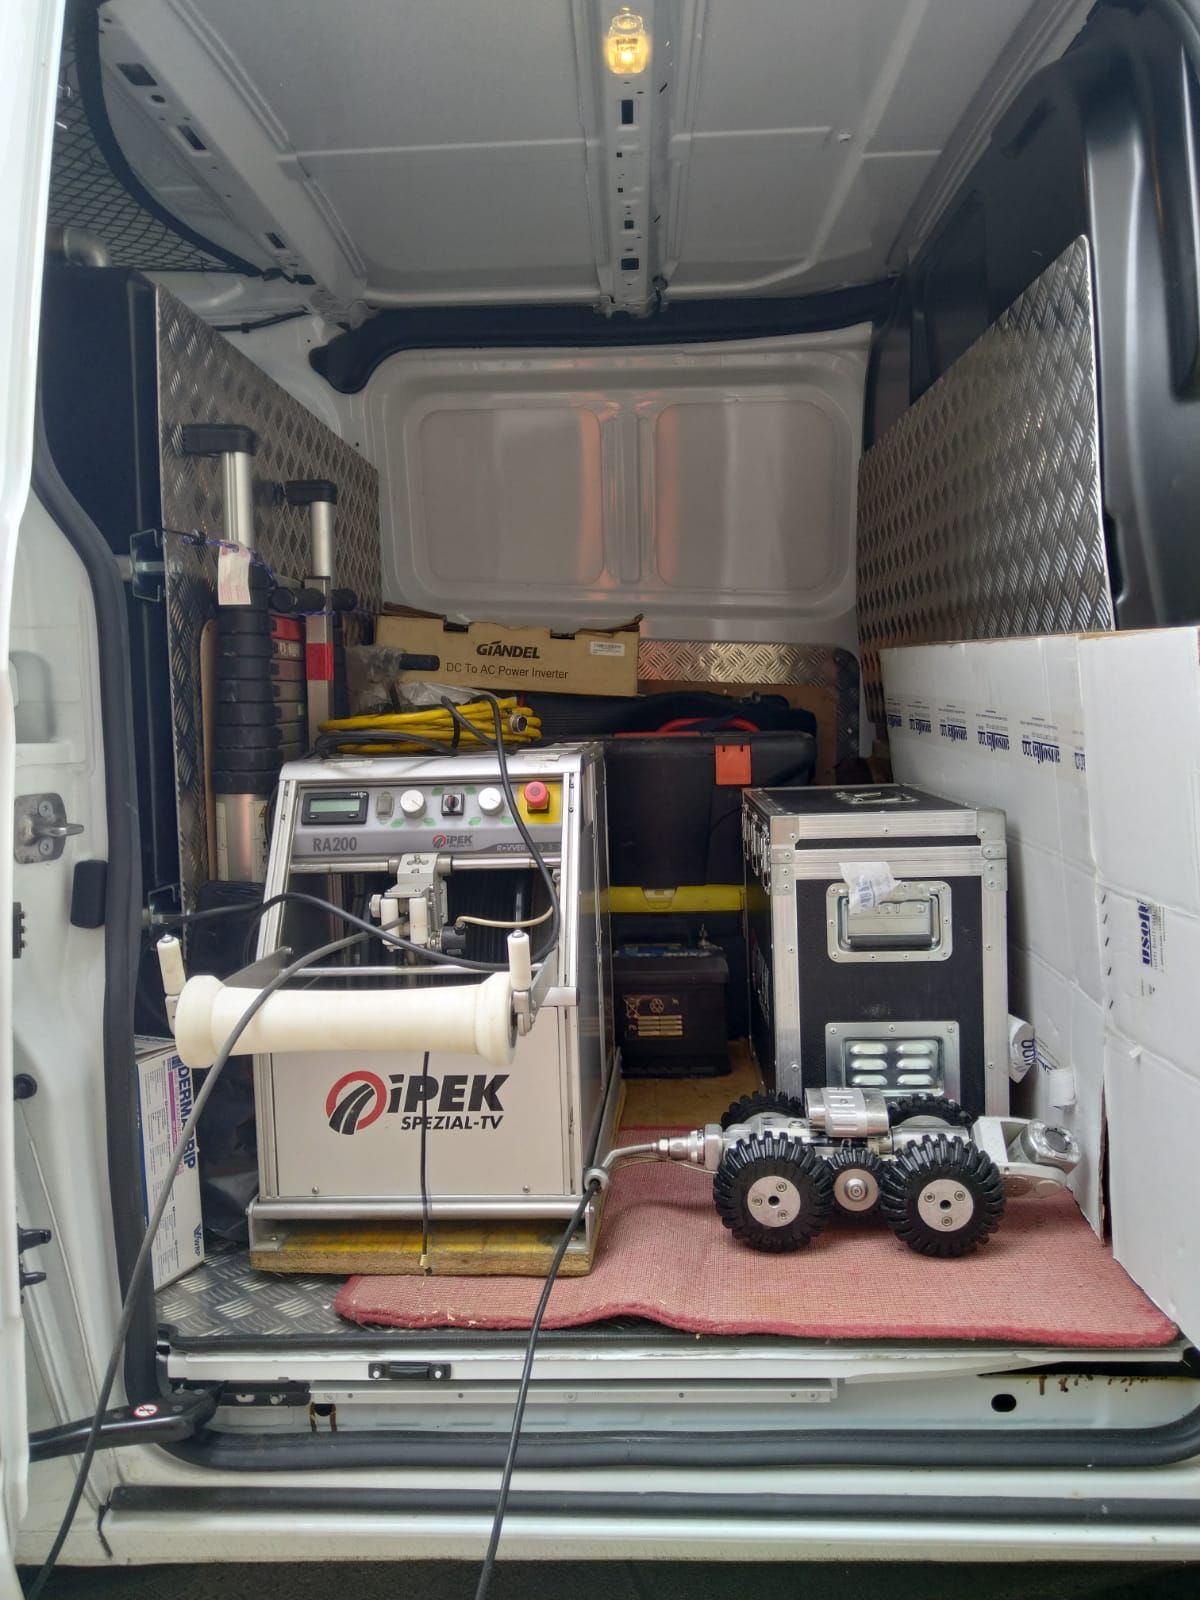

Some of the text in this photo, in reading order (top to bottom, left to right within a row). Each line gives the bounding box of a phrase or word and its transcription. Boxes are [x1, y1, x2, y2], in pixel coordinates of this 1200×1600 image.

[446, 662, 569, 680] DC To AC Power Inverter
[313, 837, 358, 852] RA200
[387, 1074, 510, 1113] iPEK
[400, 1115, 504, 1130] SPEZIAL-TV
